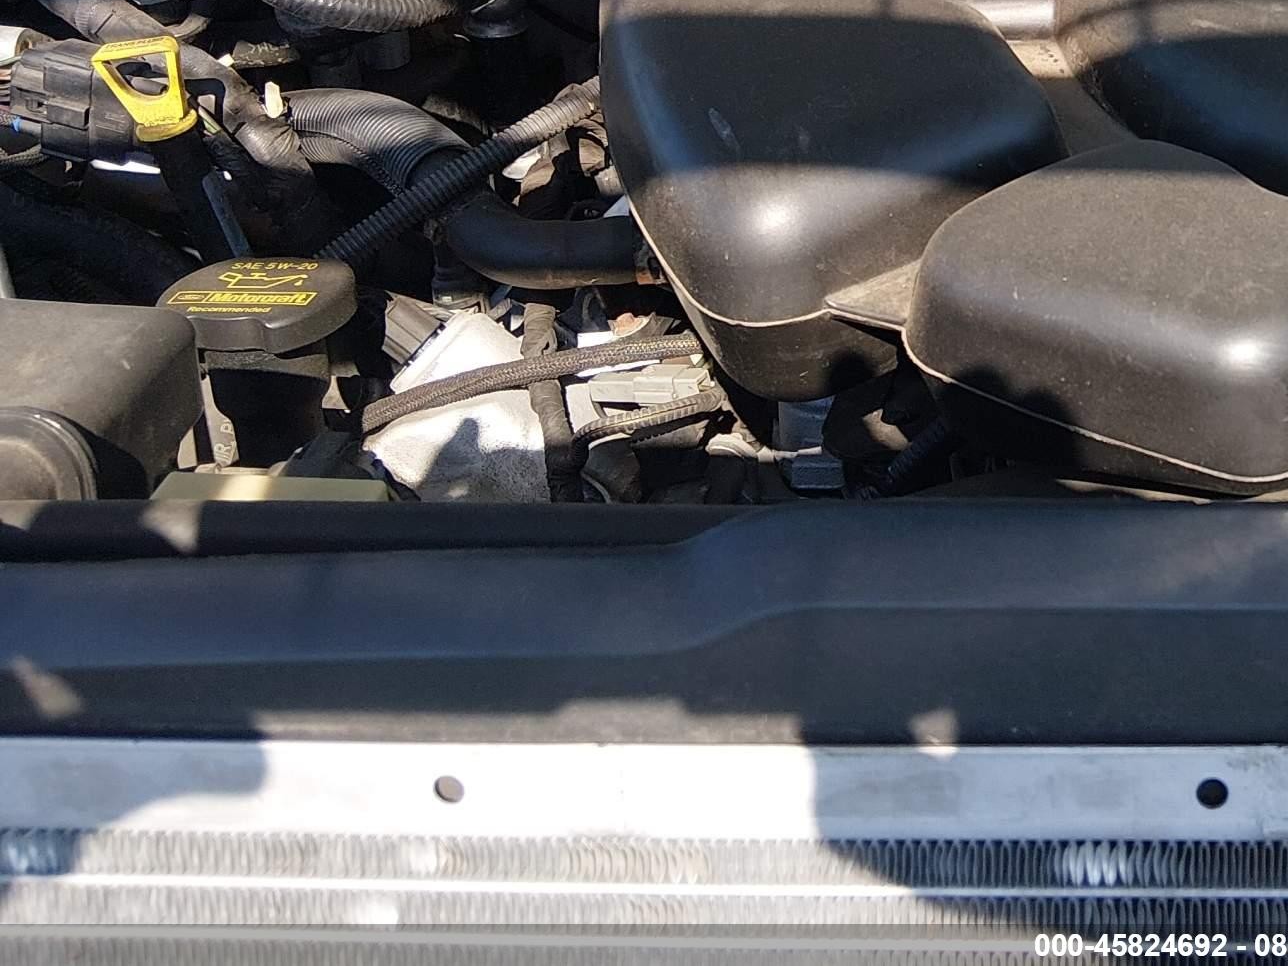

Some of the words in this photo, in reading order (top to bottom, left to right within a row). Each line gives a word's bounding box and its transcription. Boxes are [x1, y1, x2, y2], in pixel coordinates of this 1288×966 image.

[231, 262, 263, 270] SAE
[265, 262, 319, 270] 5W-20
[207, 292, 306, 303] Motorcraft
